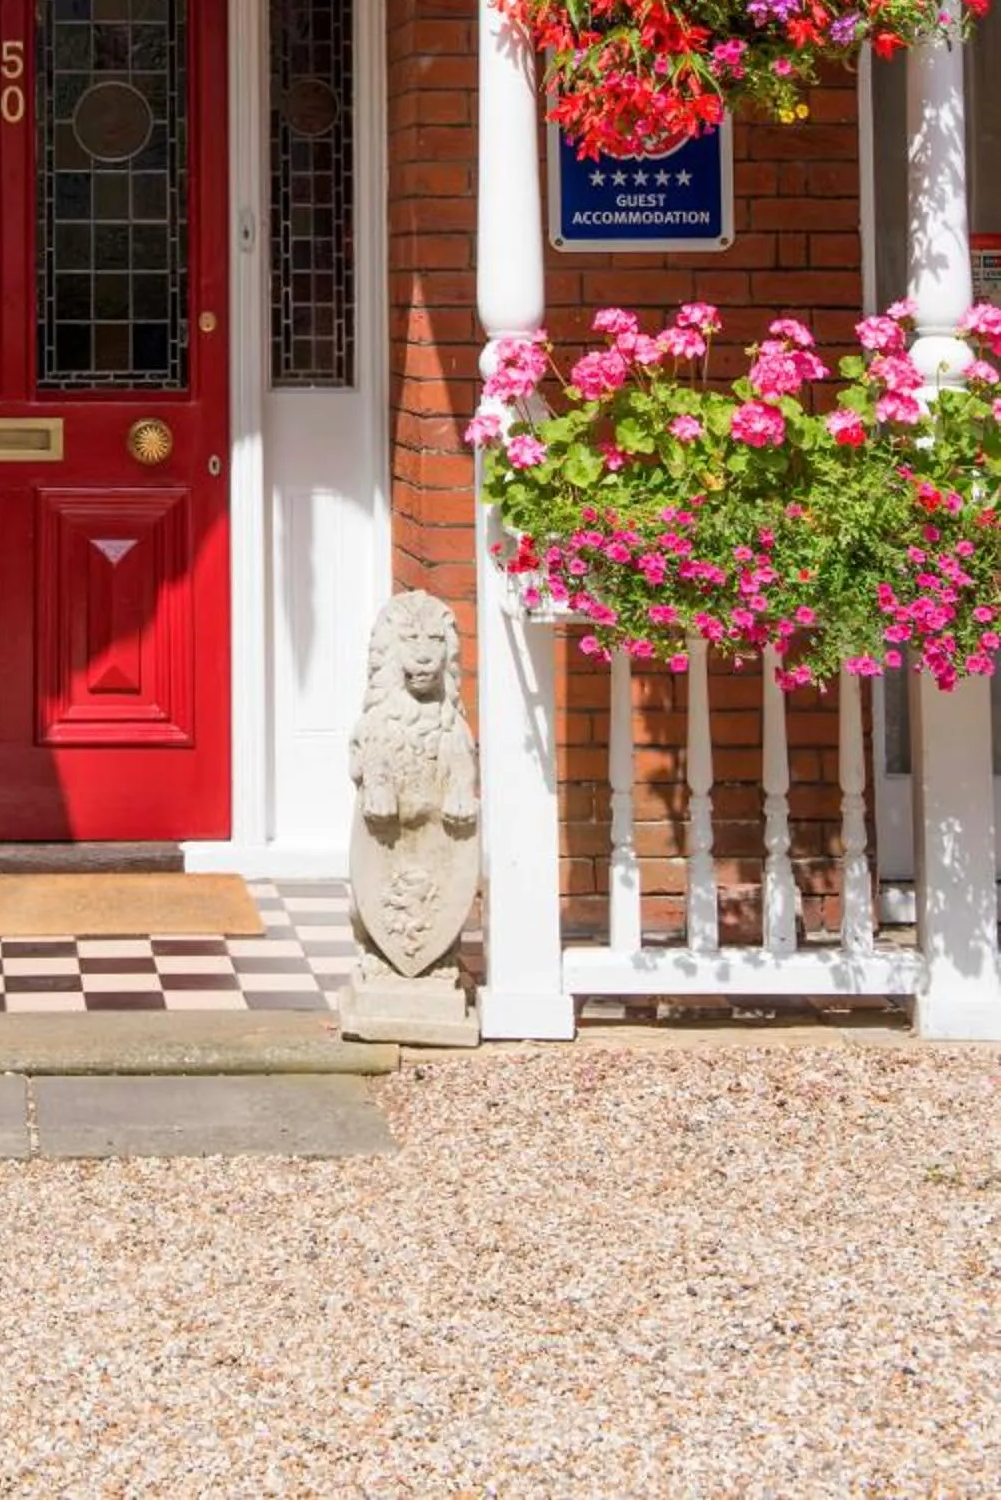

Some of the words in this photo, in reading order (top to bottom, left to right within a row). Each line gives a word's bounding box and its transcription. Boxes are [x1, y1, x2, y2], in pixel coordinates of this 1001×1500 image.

[0, 40, 25, 123] 50
[615, 193, 666, 207] GUEST
[572, 210, 710, 225] ACCOMMODATION
